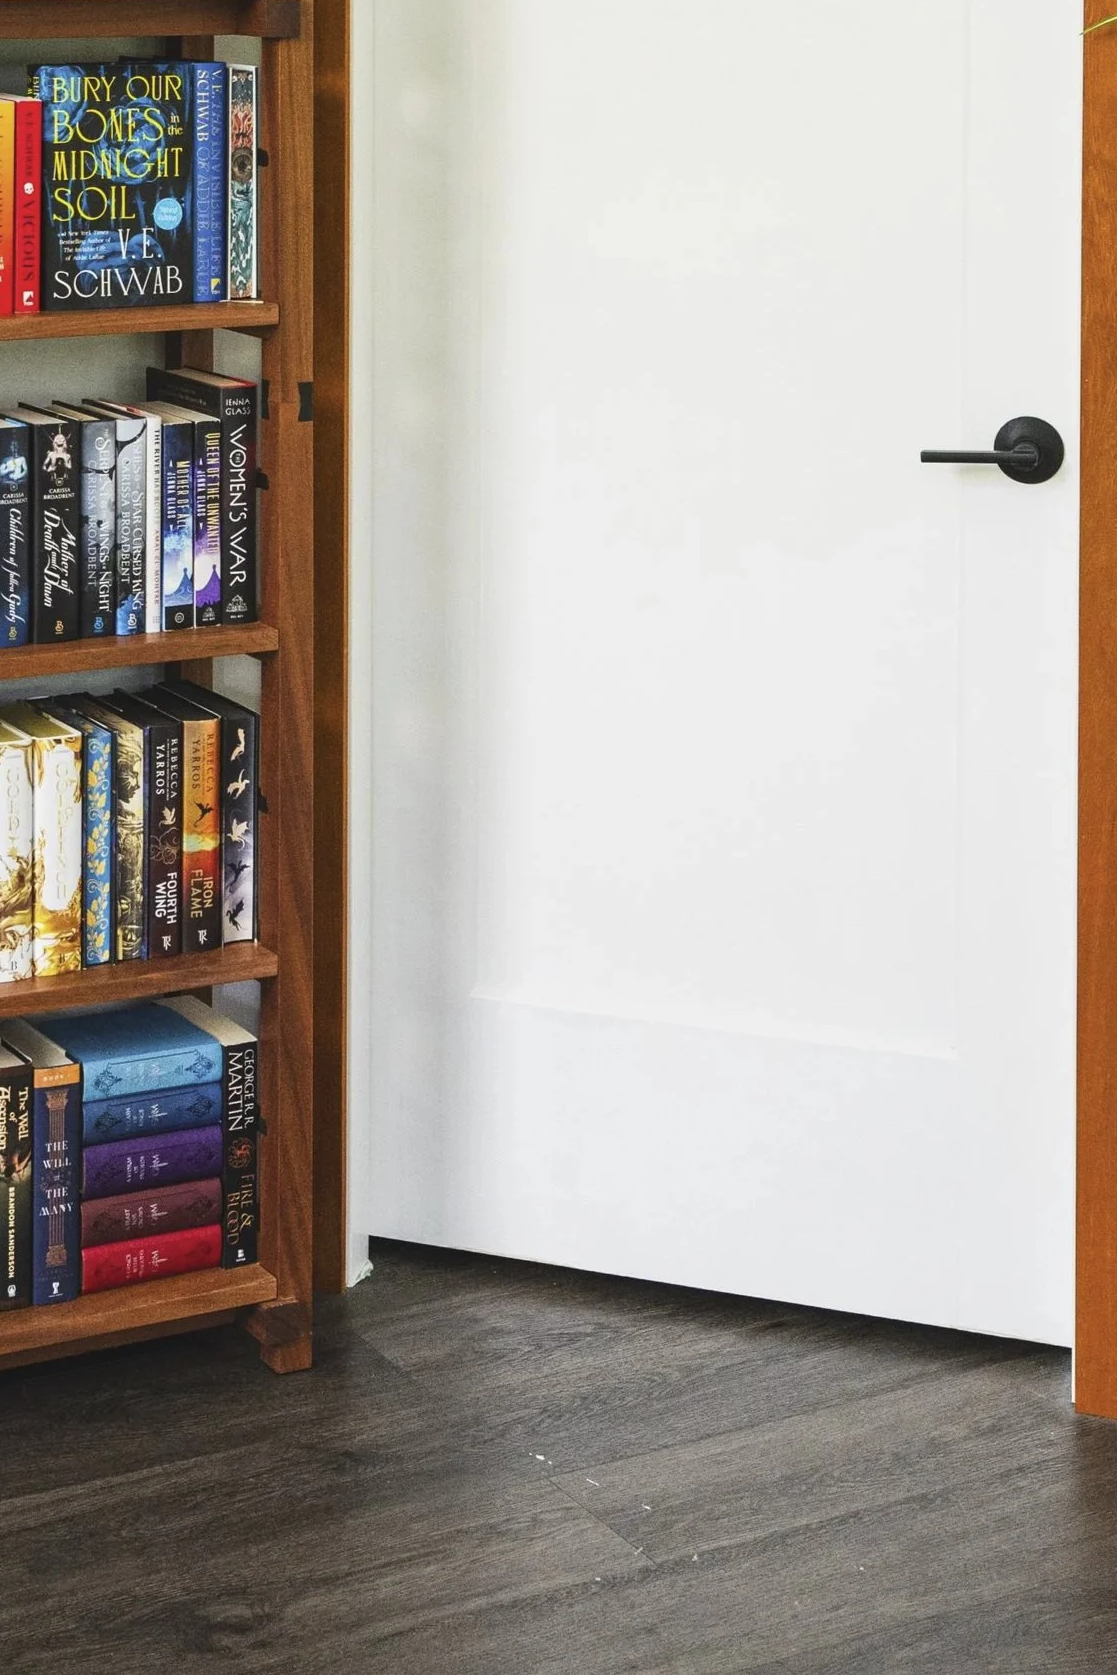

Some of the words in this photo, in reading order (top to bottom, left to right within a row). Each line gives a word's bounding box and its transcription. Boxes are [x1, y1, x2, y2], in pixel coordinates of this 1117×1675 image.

[53, 75, 115, 103] BURY
[127, 75, 182, 103] OUR
[53, 108, 163, 144] BONES
[171, 115, 180, 123] in
[168, 125, 183, 135] the
[52, 147, 183, 180] MIDNIGHT
[53, 187, 136, 222] SOIL
[54, 265, 183, 299] SCHWAB
[207, 433, 220, 466] QUEEN
[207, 470, 220, 482] OF
[207, 484, 220, 502] THE
[206, 505, 220, 554] UNWANTED
[229, 526, 247, 586] WAR
[155, 745, 164, 795] YARROS
[155, 882, 166, 918] WING
[167, 872, 177, 924] FOURTH
[191, 869, 202, 918] FLAME
[203, 876, 212, 908] IRON
[245, 1048, 254, 1096] GEORGE
[229, 1052, 245, 1131] MARTIN
[42, 1158, 71, 1168] WILL
[45, 1141, 68, 1152] THE
[45, 1187, 68, 1198] THE
[241, 1174, 254, 1206] FIRE
[40, 1202, 74, 1216] MANY
[227, 1193, 240, 1245] BLOOD
[241, 1211, 252, 1228] &
